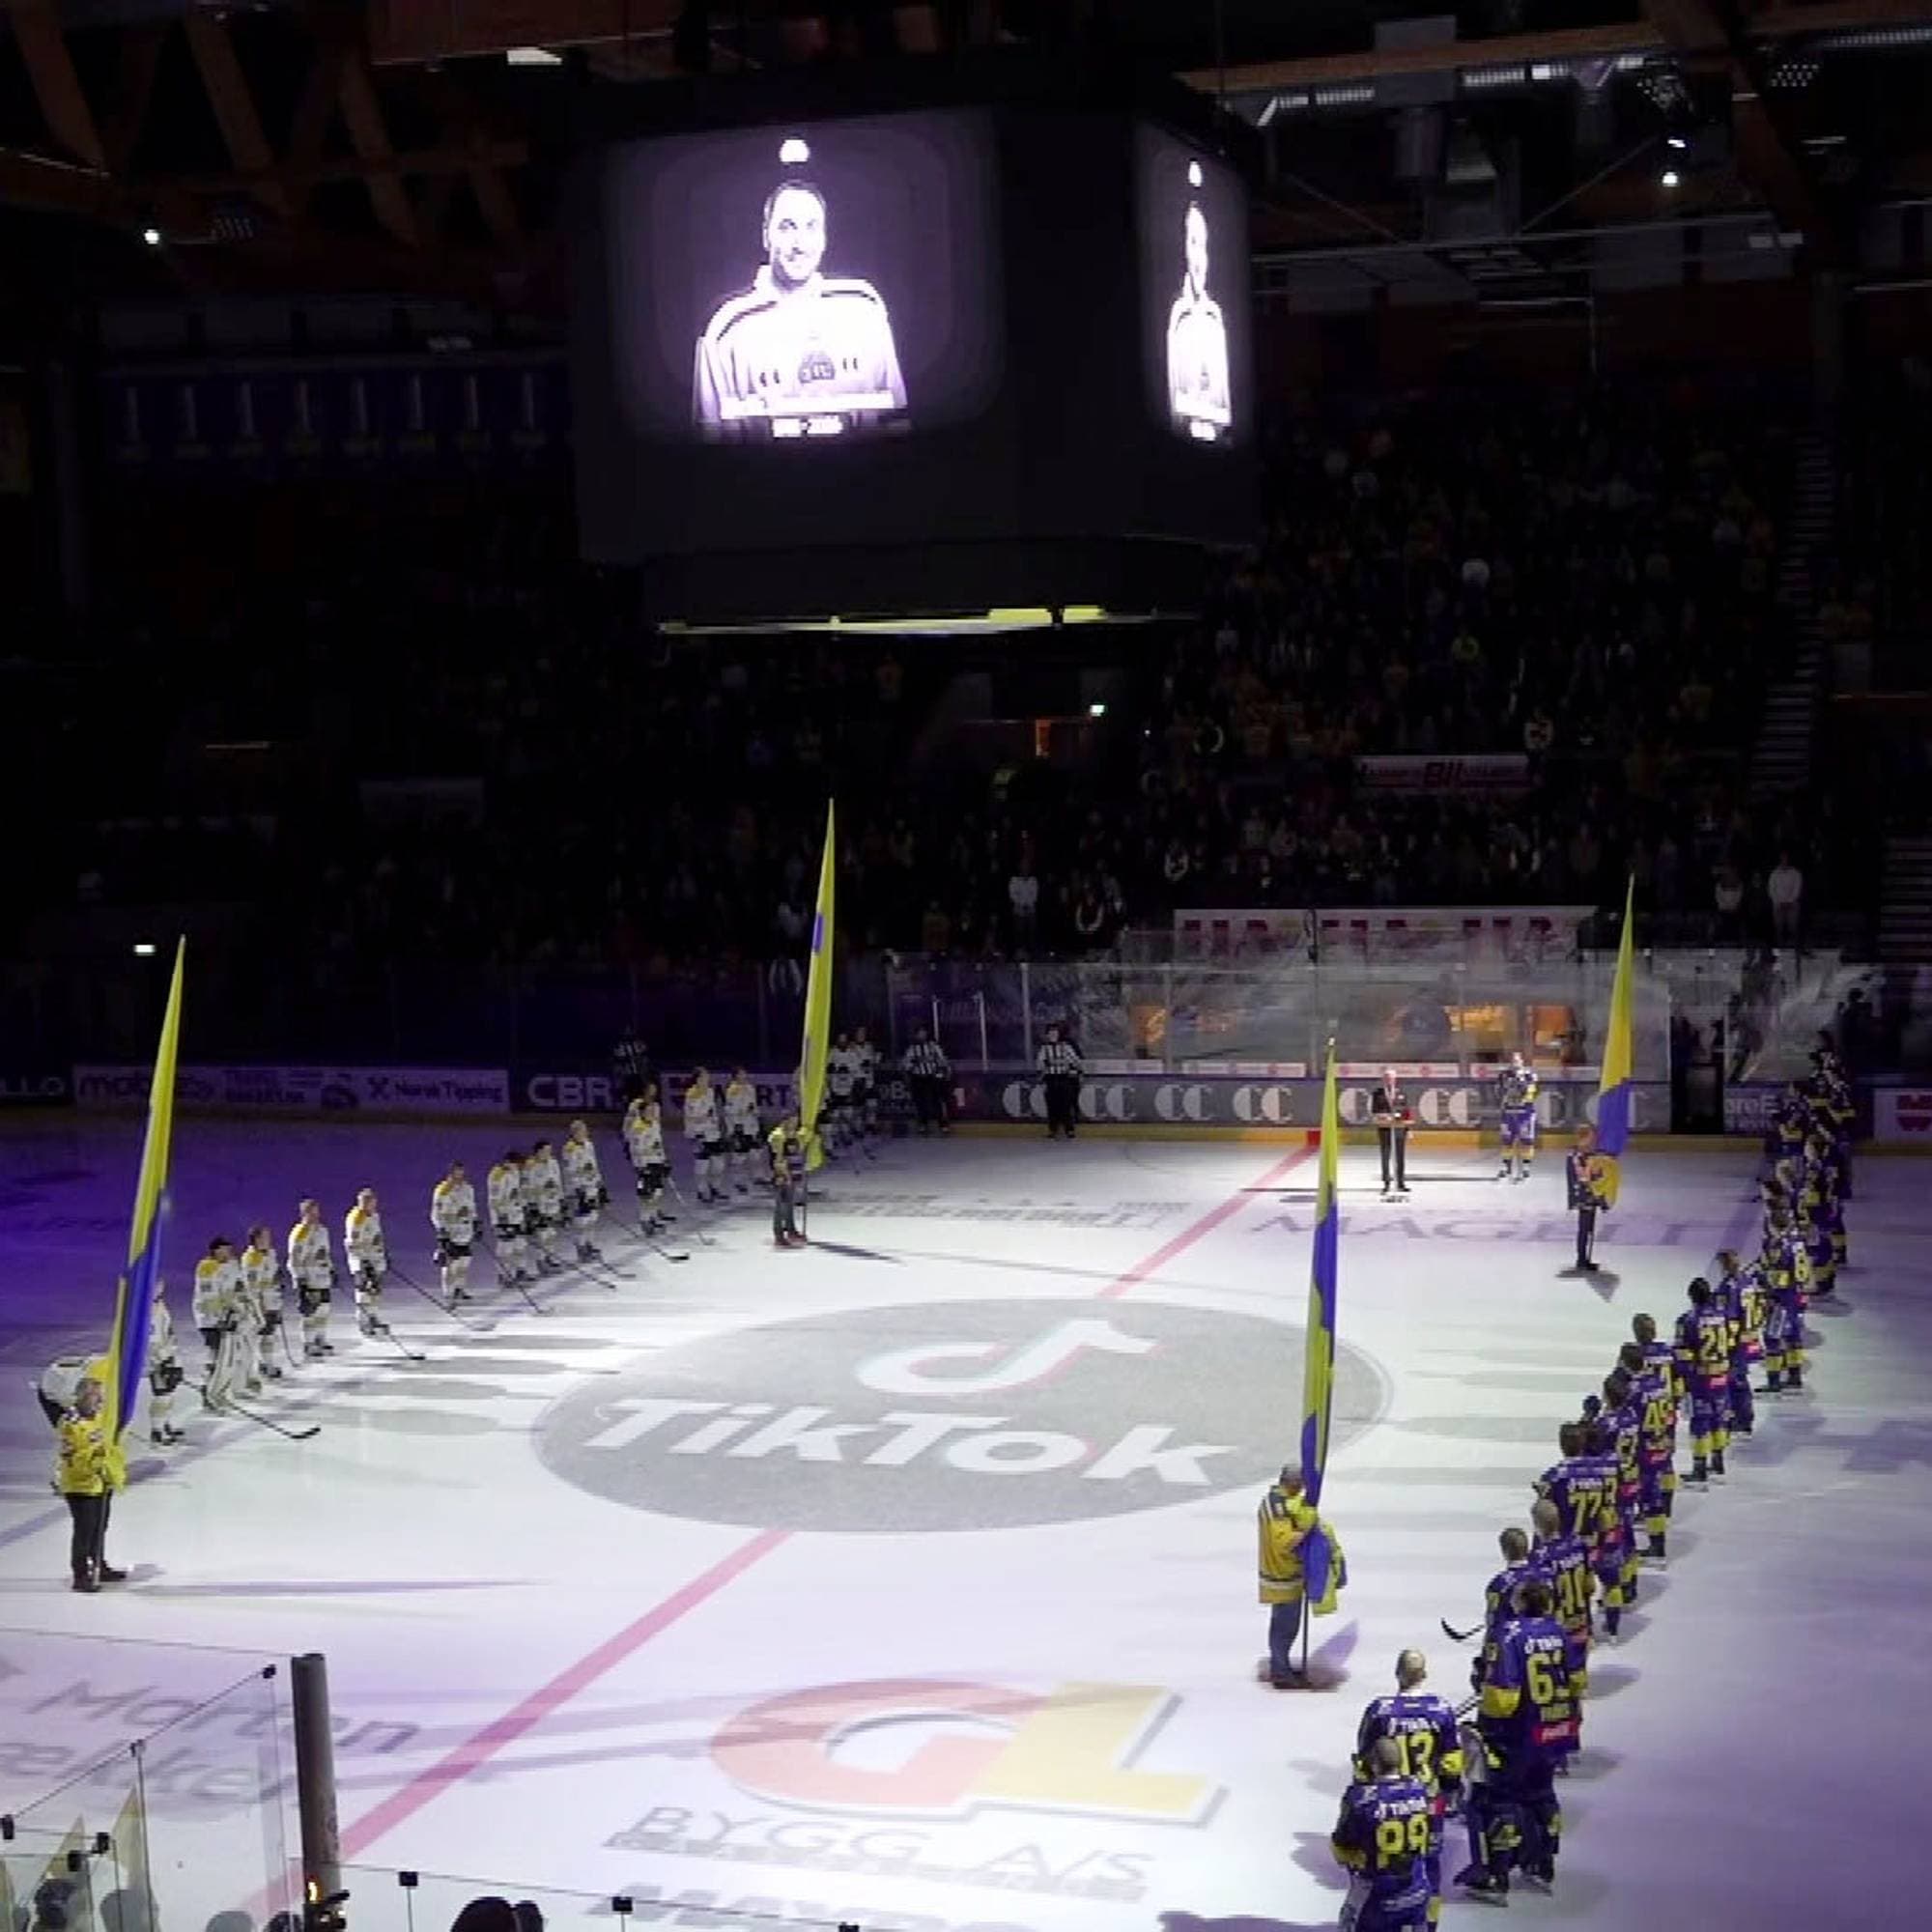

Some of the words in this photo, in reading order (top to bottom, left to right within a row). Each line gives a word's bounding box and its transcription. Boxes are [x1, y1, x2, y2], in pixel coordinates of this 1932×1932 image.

[527, 1076, 613, 1108] CBR
[584, 1398, 1238, 1487] TikTok
[621, 1805, 933, 1864] BYGG
